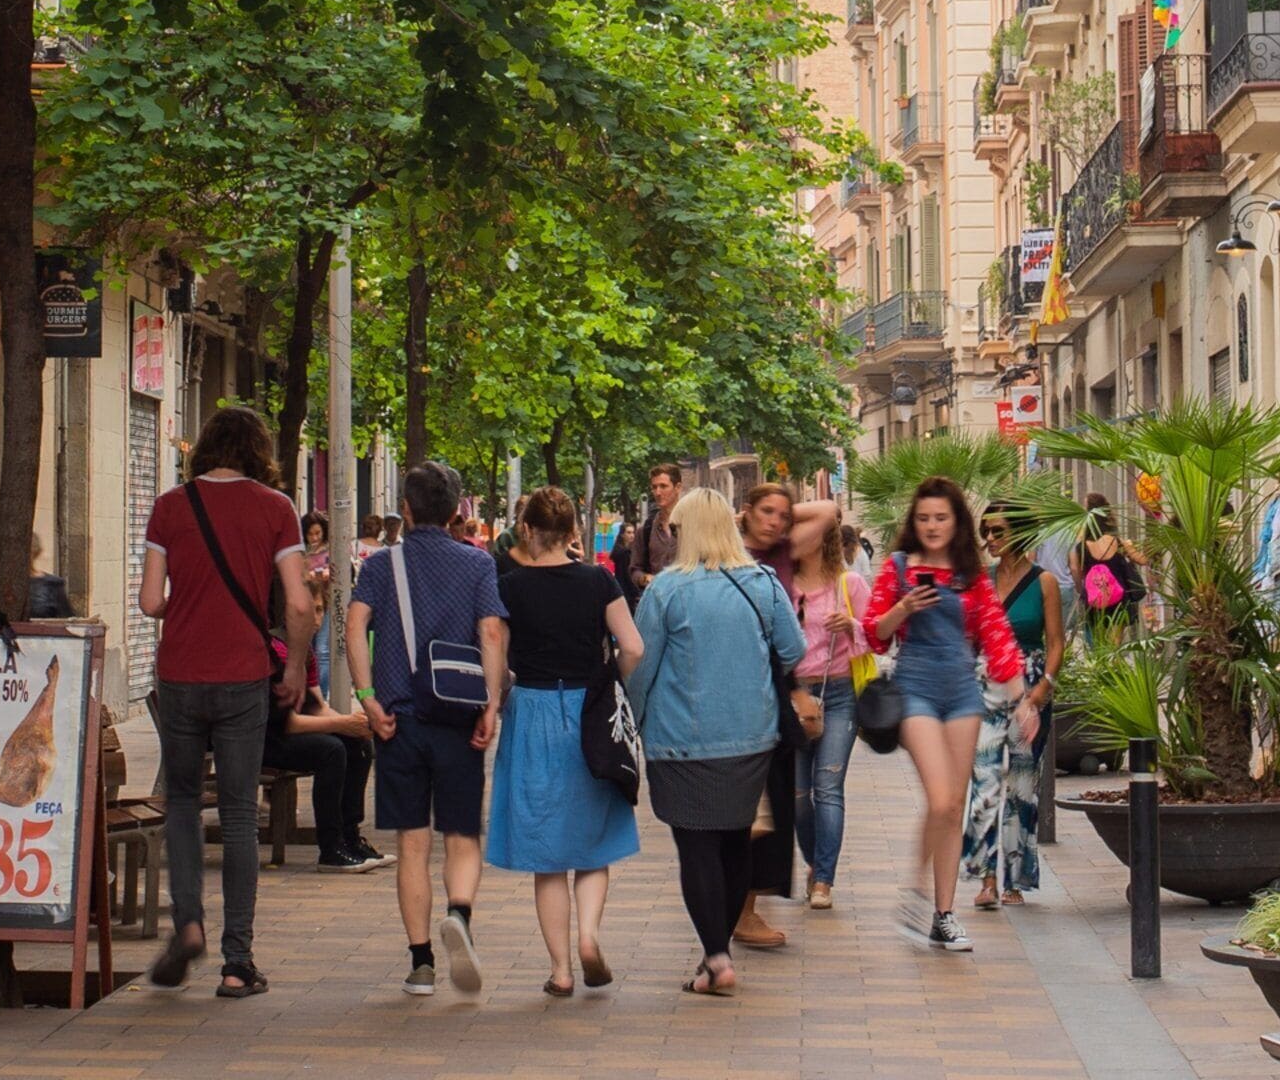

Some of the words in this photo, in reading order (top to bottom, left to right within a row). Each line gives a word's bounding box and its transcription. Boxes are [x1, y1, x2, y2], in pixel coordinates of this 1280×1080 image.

[46, 307, 87, 316] OURMET
[46, 315, 87, 324] URGERS
[2, 679, 29, 703] 50%
[35, 801, 63, 816] PEÇA
